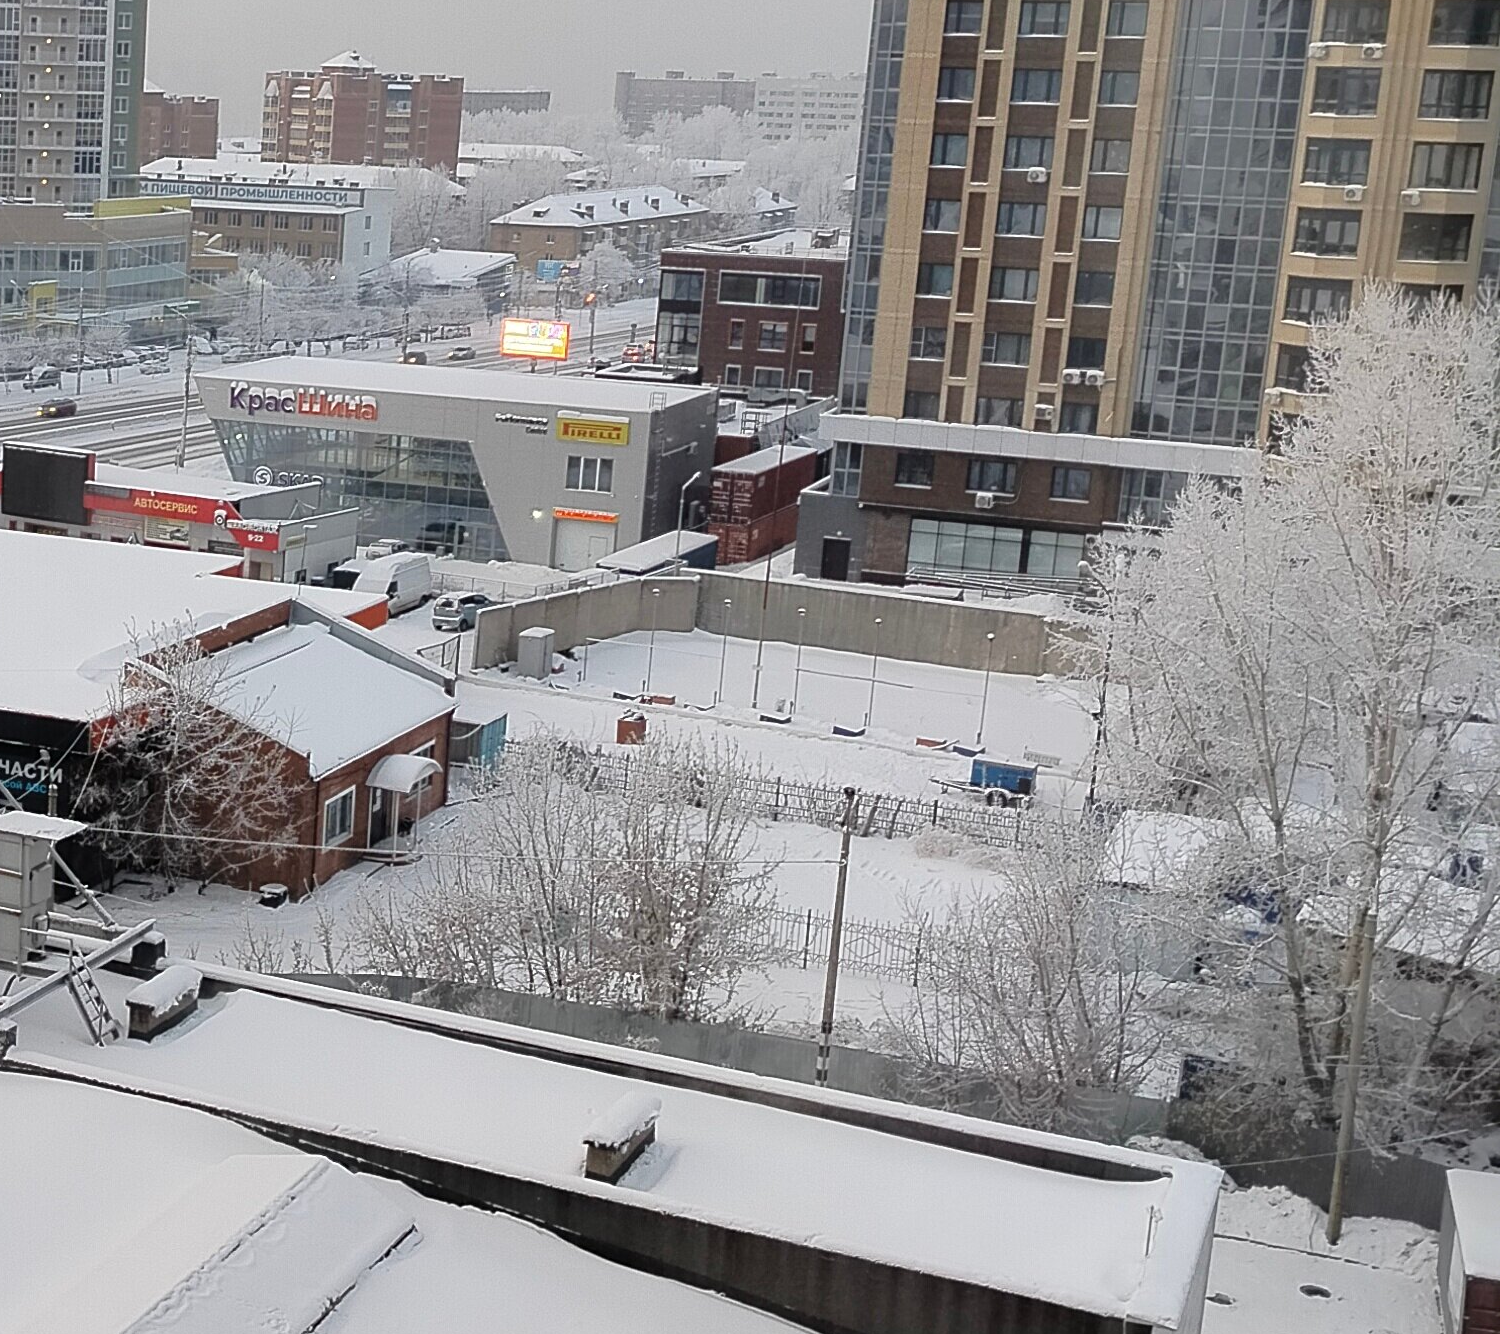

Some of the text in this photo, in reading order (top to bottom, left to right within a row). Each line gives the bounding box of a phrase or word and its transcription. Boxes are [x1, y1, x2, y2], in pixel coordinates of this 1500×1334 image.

[151, 182, 214, 196] ПИЩЕВОЙ
[220, 187, 348, 202] ПРОМЫШЛЕННОСТИ
[229, 382, 378, 421] КрасШина
[562, 422, 622, 440] PIRELLI
[133, 497, 198, 514] АВТОСЕРВИС
